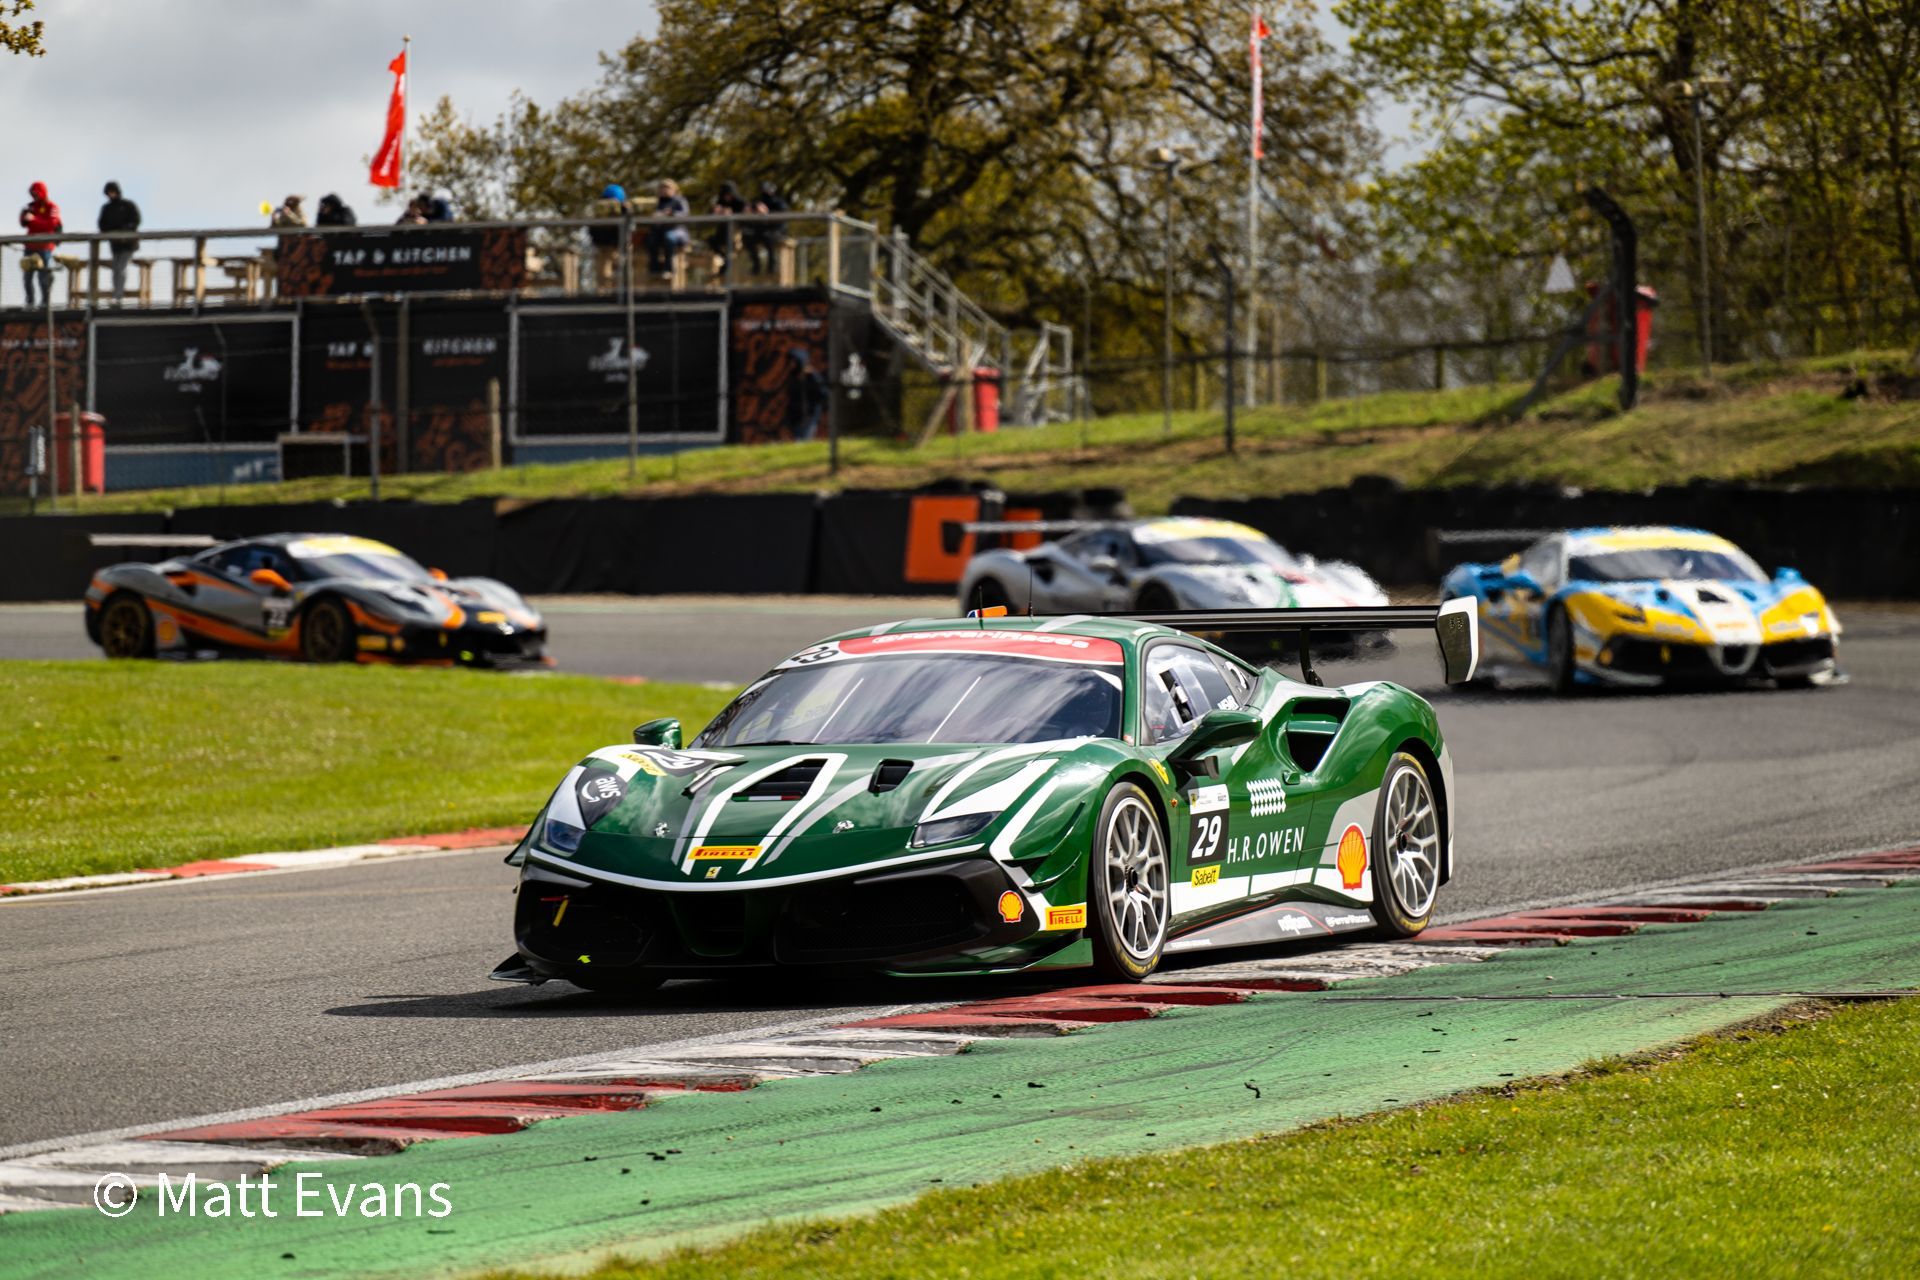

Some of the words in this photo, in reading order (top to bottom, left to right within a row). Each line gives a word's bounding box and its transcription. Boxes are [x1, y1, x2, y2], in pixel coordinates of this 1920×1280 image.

[333, 249, 366, 265] TAP
[373, 249, 385, 264] &
[392, 246, 471, 263] KITCHEN
[327, 342, 357, 357] TAP
[422, 338, 497, 354] KITCHEN
[791, 646, 839, 664] 29
[595, 776, 621, 799] aws
[1191, 815, 1222, 859] 29
[695, 848, 756, 858] PIRELLI
[1193, 869, 1217, 886] Sabelt
[1049, 909, 1083, 925] PIRELLI
